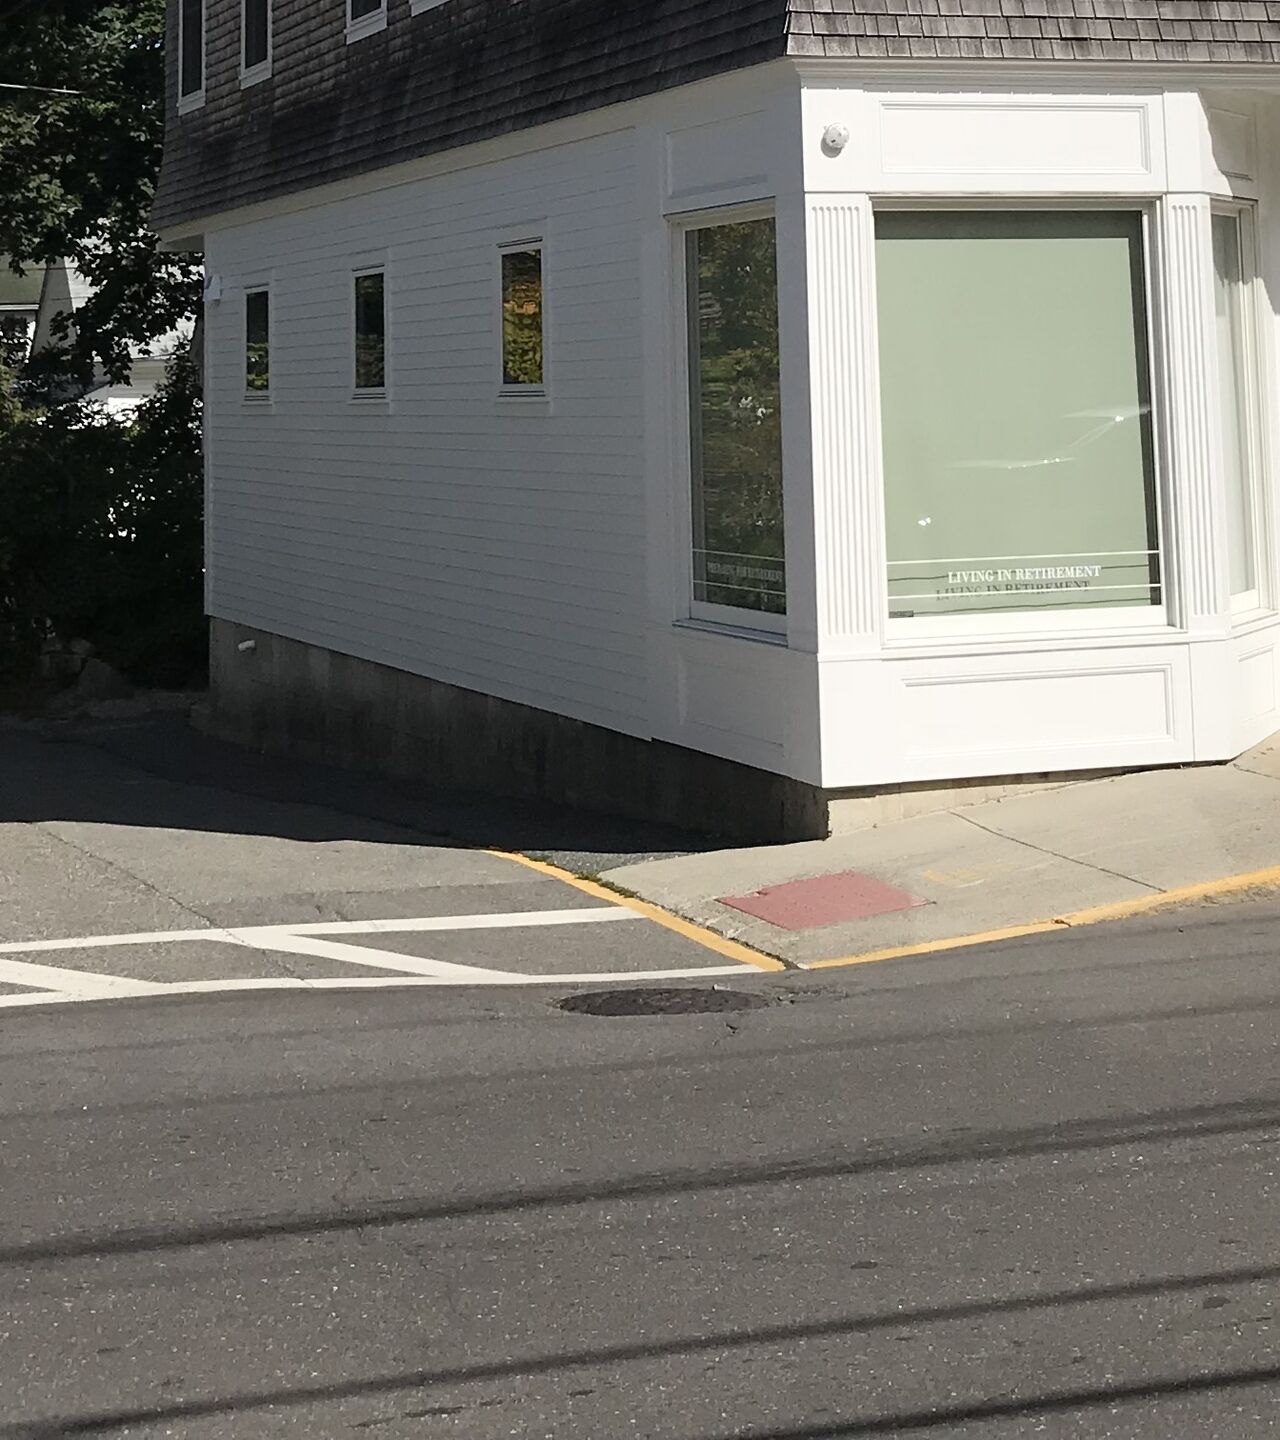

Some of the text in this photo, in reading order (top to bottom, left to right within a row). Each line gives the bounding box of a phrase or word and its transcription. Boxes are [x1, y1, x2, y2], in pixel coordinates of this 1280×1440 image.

[948, 565, 1102, 584] LIVING IN RETIREMENT
